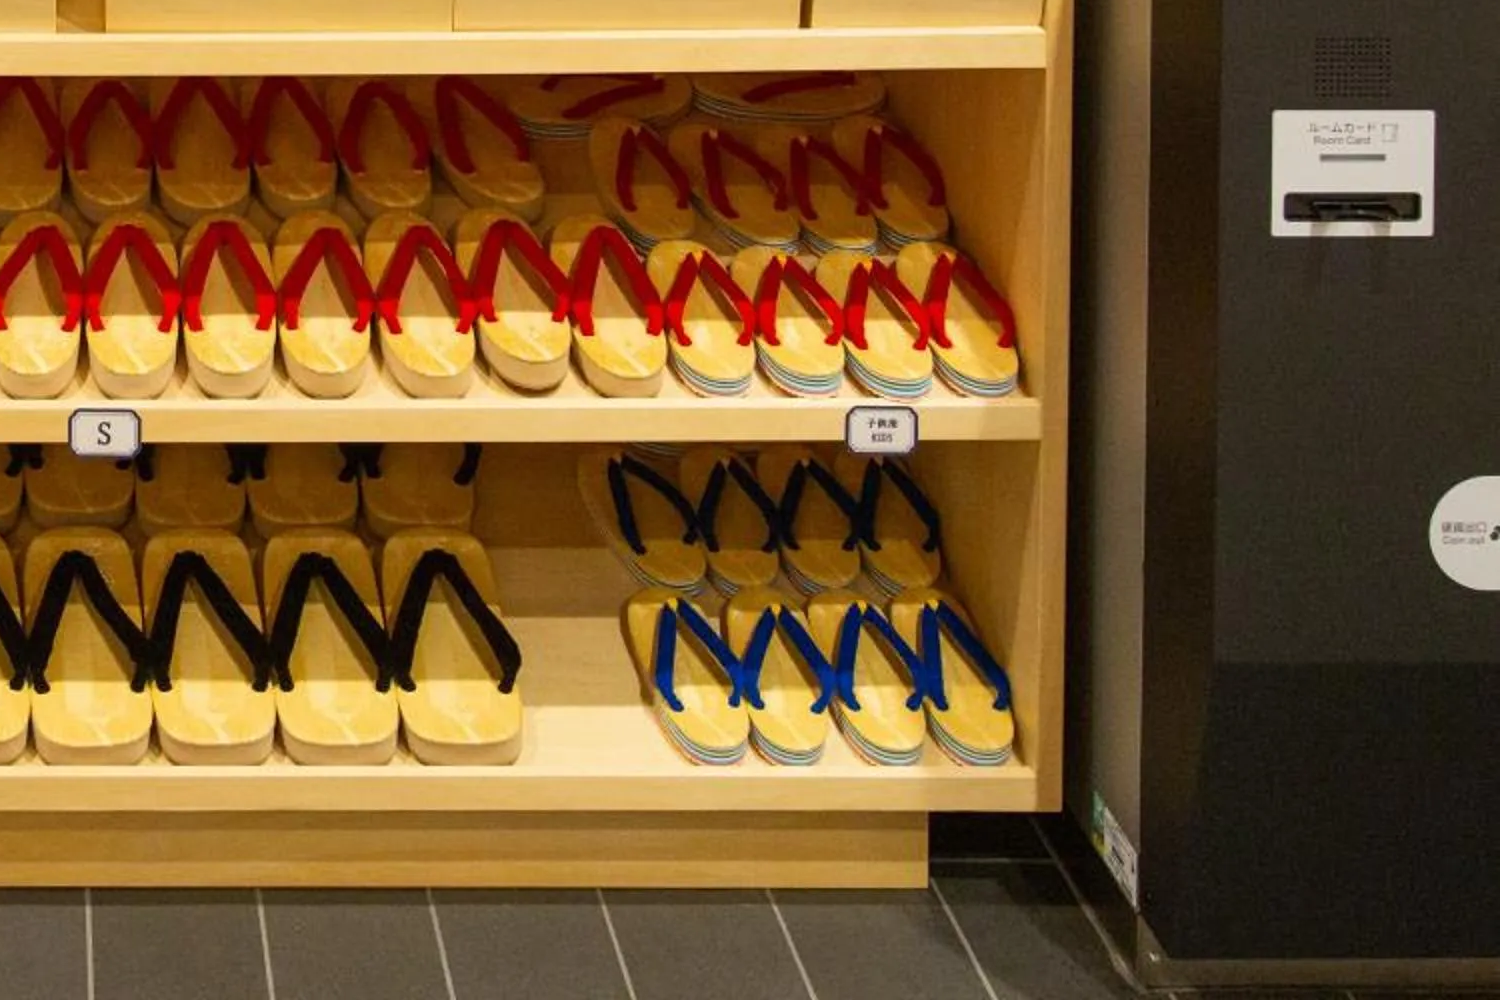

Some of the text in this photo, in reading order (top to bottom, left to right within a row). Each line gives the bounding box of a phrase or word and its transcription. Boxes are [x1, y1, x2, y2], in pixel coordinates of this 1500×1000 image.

[1307, 122, 1377, 134] ルームカード
[1313, 135, 1372, 145] Room Card
[96, 421, 112, 446] S
